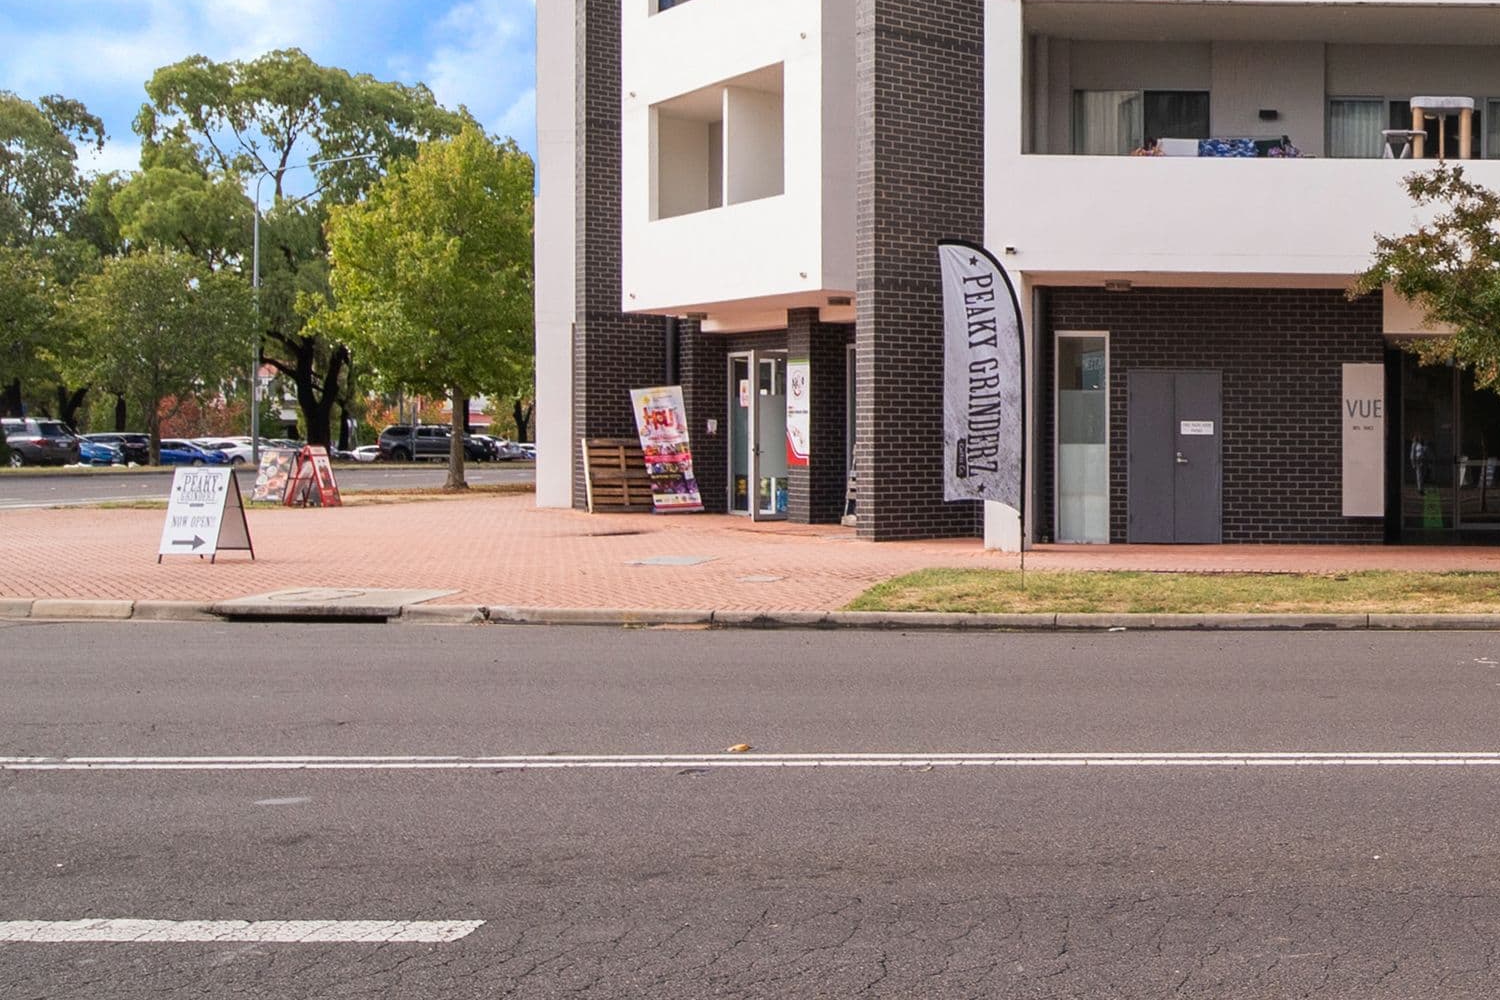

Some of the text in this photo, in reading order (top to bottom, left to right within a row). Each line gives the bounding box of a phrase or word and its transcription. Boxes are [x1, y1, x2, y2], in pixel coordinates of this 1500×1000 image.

[962, 272, 1001, 477] PEAKY GRINDERZ
[1346, 399, 1382, 418] VUE
[183, 475, 219, 492] PEAKY
